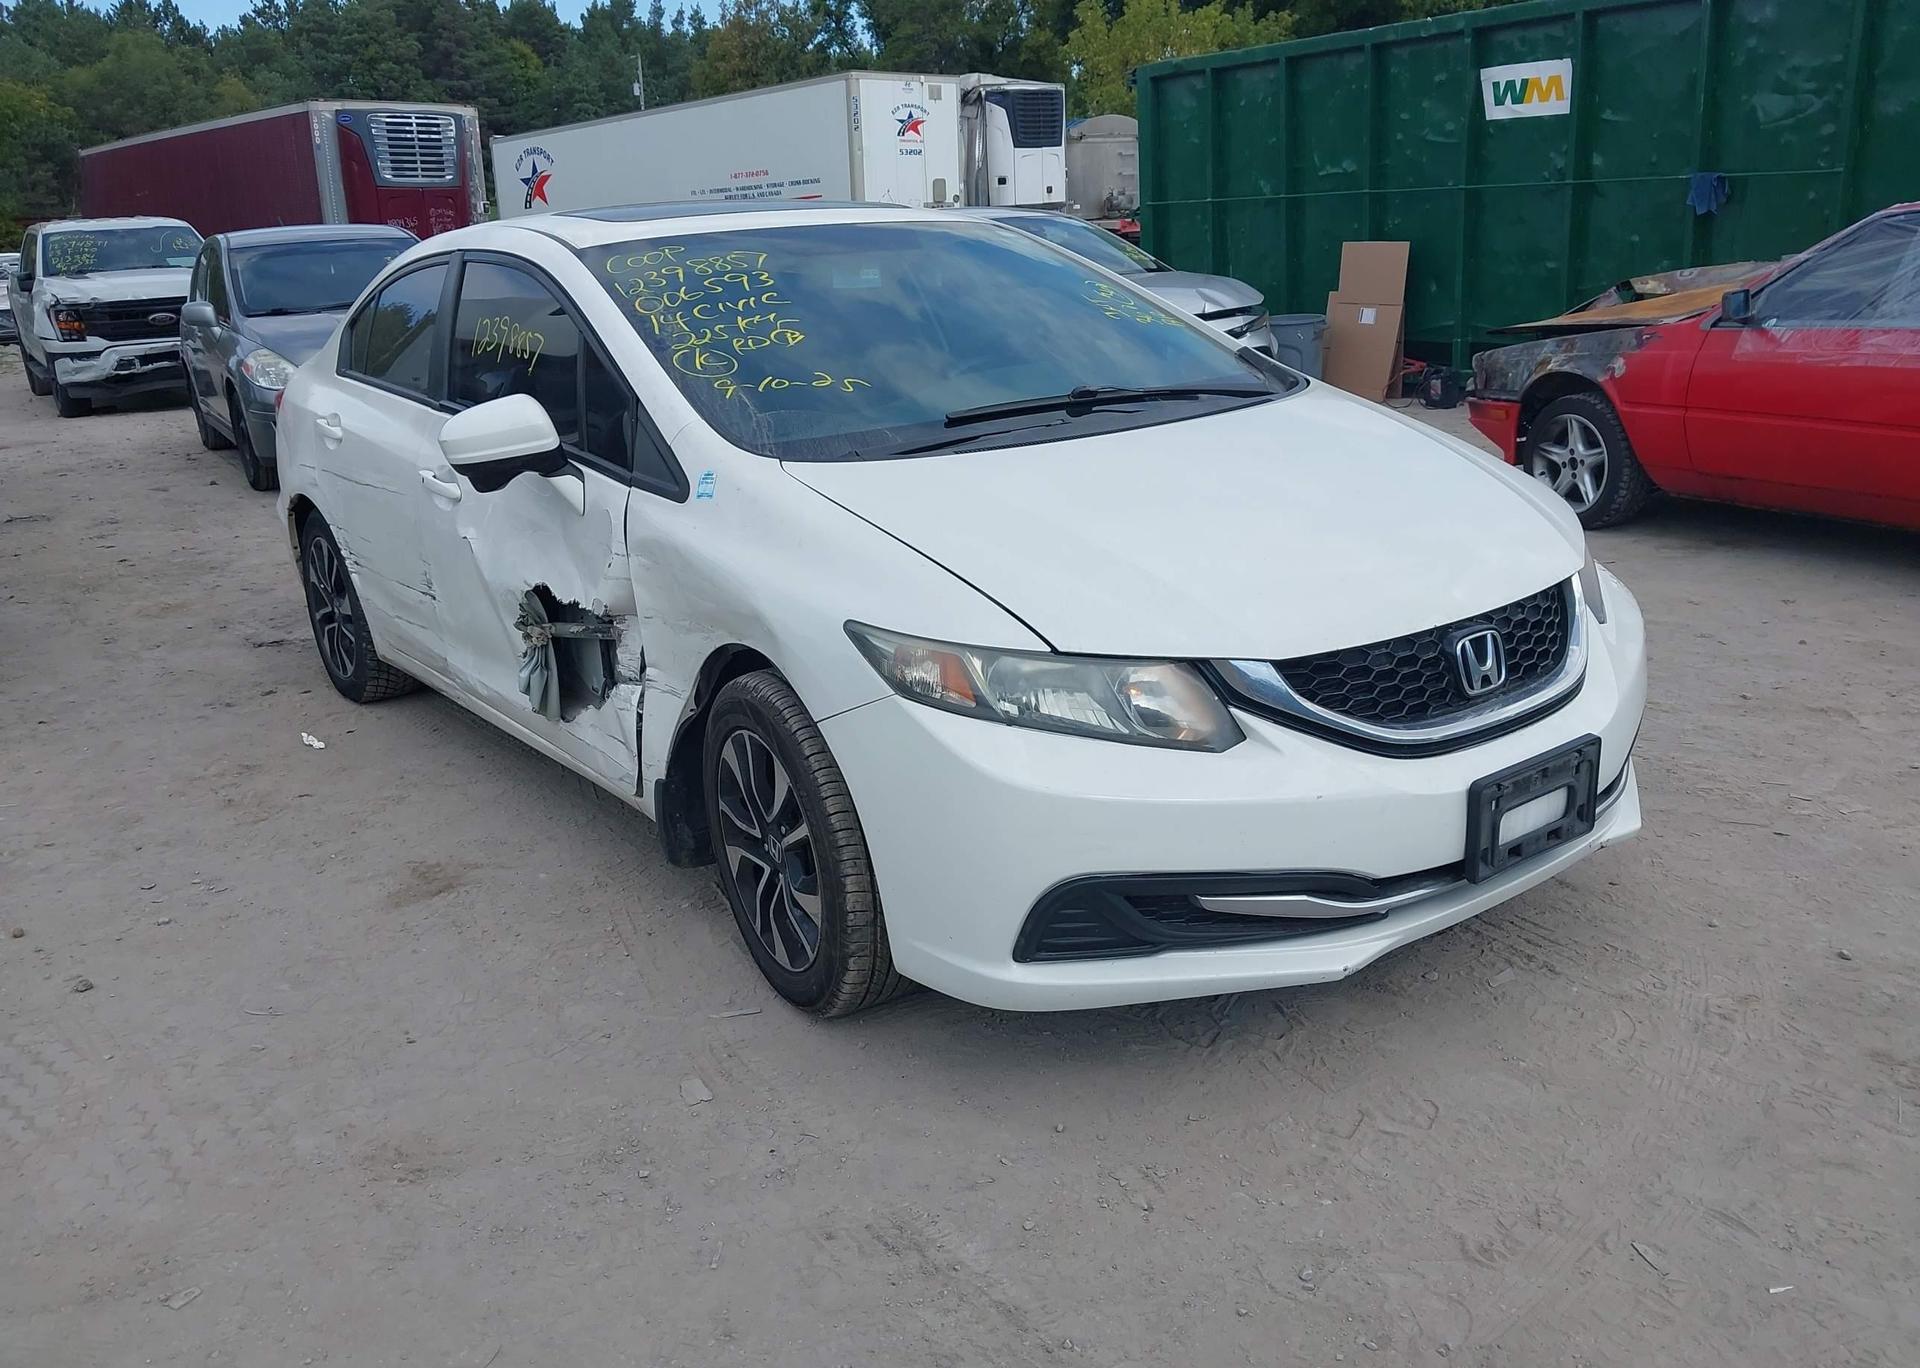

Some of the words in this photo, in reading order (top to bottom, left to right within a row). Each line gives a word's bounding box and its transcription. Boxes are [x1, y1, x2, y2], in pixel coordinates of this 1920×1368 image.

[1492, 74, 1565, 107] WM
[523, 146, 554, 166] TRANSPORT
[651, 311, 690, 335] 14
